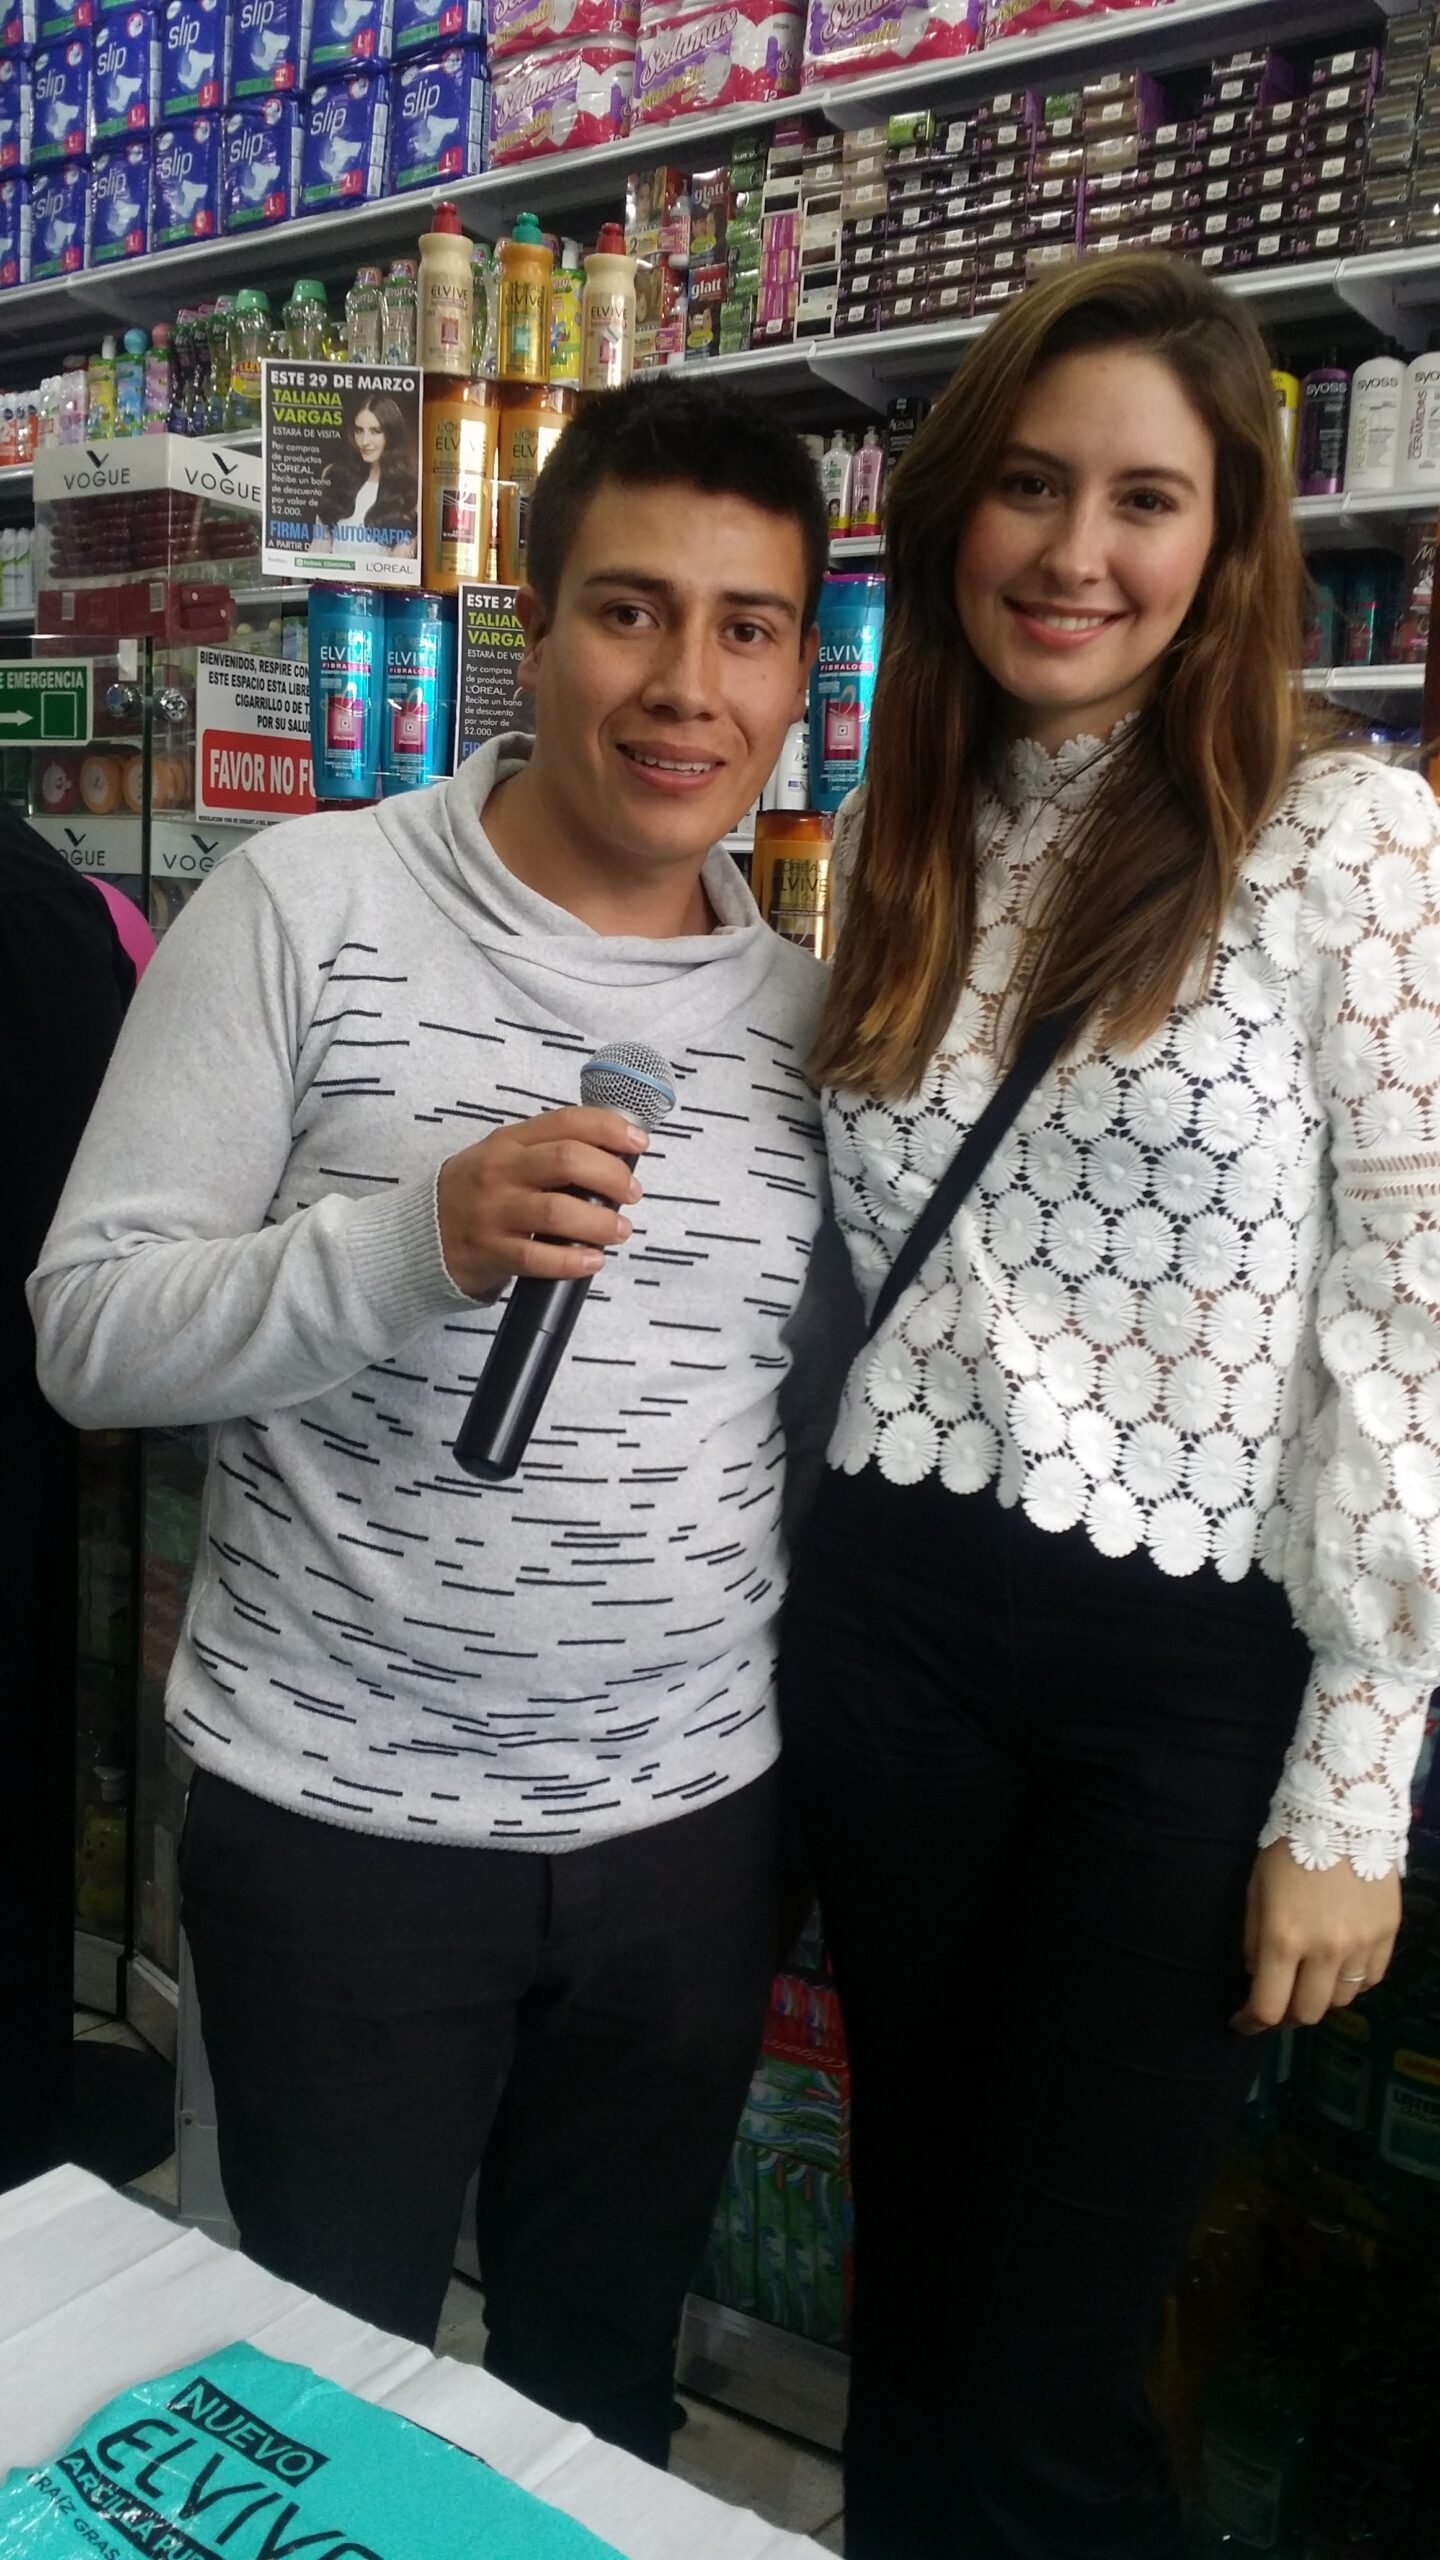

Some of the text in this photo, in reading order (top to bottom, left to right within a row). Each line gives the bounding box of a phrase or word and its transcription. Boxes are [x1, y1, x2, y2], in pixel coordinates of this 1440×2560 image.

[240, 0, 275, 32] slip
[168, 16, 201, 51] slip
[97, 43, 128, 77] slip
[36, 69, 65, 101] slip
[403, 79, 440, 120] slip
[311, 102, 347, 139] slip
[229, 129, 264, 165] slip
[161, 147, 193, 182] slip
[97, 168, 127, 201] slip
[694, 182, 725, 204] glatt
[35, 188, 64, 221] slip
[431, 284, 468, 298] ELVIVE
[691, 278, 722, 300] glatt
[591, 306, 628, 318] ELVIVE
[271, 370, 415, 392] ESTE 29 DE MARZO
[1357, 377, 1399, 391] syoss
[1415, 370, 1440, 384] syo
[272, 389, 342, 405] TALIANA
[1306, 382, 1347, 397] syoss
[272, 408, 343, 425] VARGAS
[304, 429, 315, 438] DE
[317, 430, 341, 439] VISITA
[272, 441, 320, 453] Por compras
[284, 455, 322, 465] productos
[64, 468, 131, 490] VOGUE
[184, 467, 262, 503] VOGUE
[272, 474, 297, 483] Recibe
[272, 485, 322, 496] de descuento
[272, 496, 284, 504] por
[287, 498, 306, 506] valor
[270, 520, 412, 545] FIRMA DE AUTÓGRAFOS
[276, 541, 302, 550] PARTIR
[467, 594, 499, 609] ESTE
[469, 612, 523, 628] TALIAN
[468, 631, 525, 647] VARGA
[320, 646, 371, 661] ELVE
[468, 649, 494, 659] ESTARÁ
[497, 651, 508, 660] DE
[200, 651, 257, 674] BIENVENIDOS,
[259, 660, 292, 677] RESPIRE
[467, 664, 512, 675] Por compras
[820, 663, 872, 671] FIBRALO
[6, 671, 84, 689] EMERGENCIA
[209, 671, 310, 697] ESTE ESPACIO ESTA LIBRE
[477, 677, 514, 685] productos
[235, 693, 283, 711] CIGARRILLO
[284, 700, 291, 711] O
[292, 701, 303, 713] DE
[466, 696, 489, 705] Recibe
[503, 699, 523, 707] bono
[476, 709, 514, 717] descuento
[257, 715, 273, 729] POR
[275, 717, 286, 731] SU
[465, 718, 510, 727] por valor de
[465, 727, 494, 736] $2.000.
[209, 749, 266, 793] FAVOR
[270, 755, 295, 795] NO
[58, 849, 105, 866] OGUE
[163, 853, 215, 872] VOG
[177, 2384, 314, 2477] NUEVO
[61, 2456, 153, 2545] ARCILLA
[73, 2517, 120, 2560] GRAS
